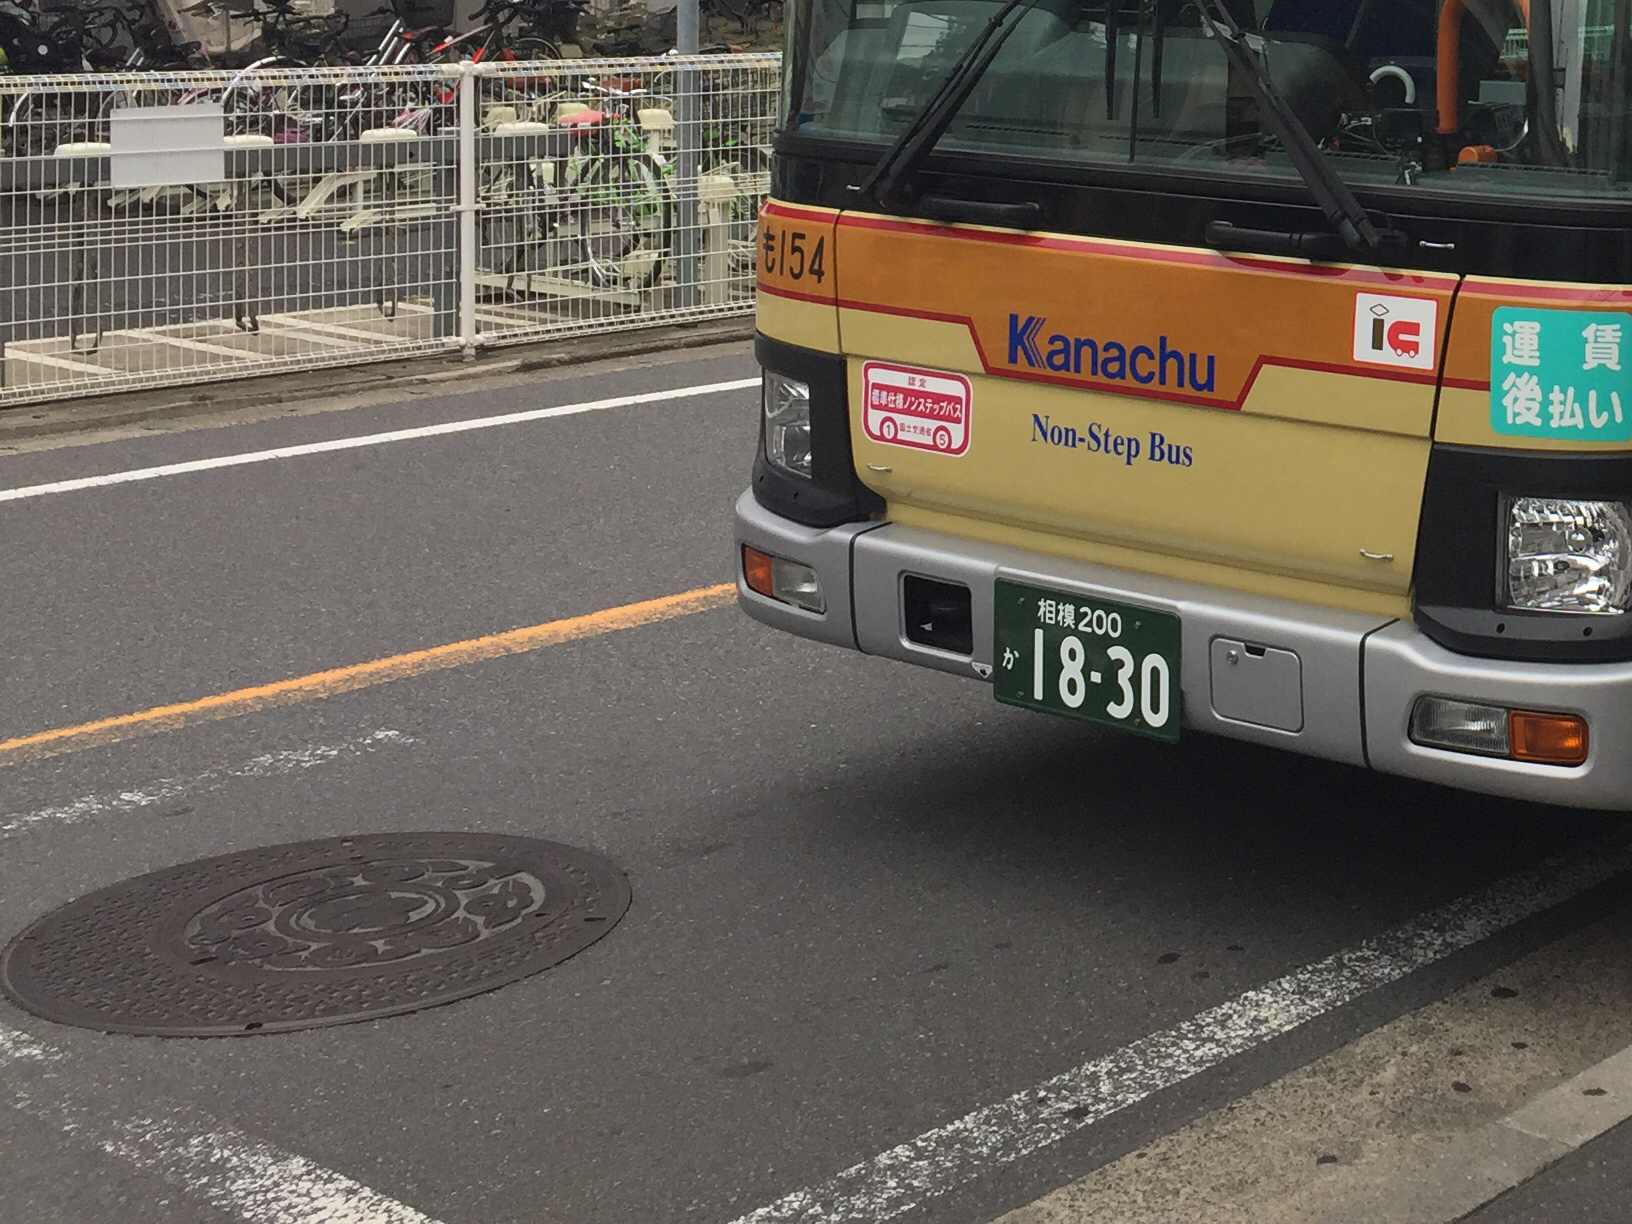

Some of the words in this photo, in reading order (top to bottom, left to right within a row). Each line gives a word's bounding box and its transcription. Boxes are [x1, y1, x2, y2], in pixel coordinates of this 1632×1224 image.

[1008, 312, 1216, 393] Kanachu
[1501, 372, 1624, 430] 後払い
[1030, 412, 1141, 466] Non-Step
[1149, 429, 1194, 468] Bus
[1002, 647, 1019, 671] か
[1033, 628, 1170, 728] 18-30
